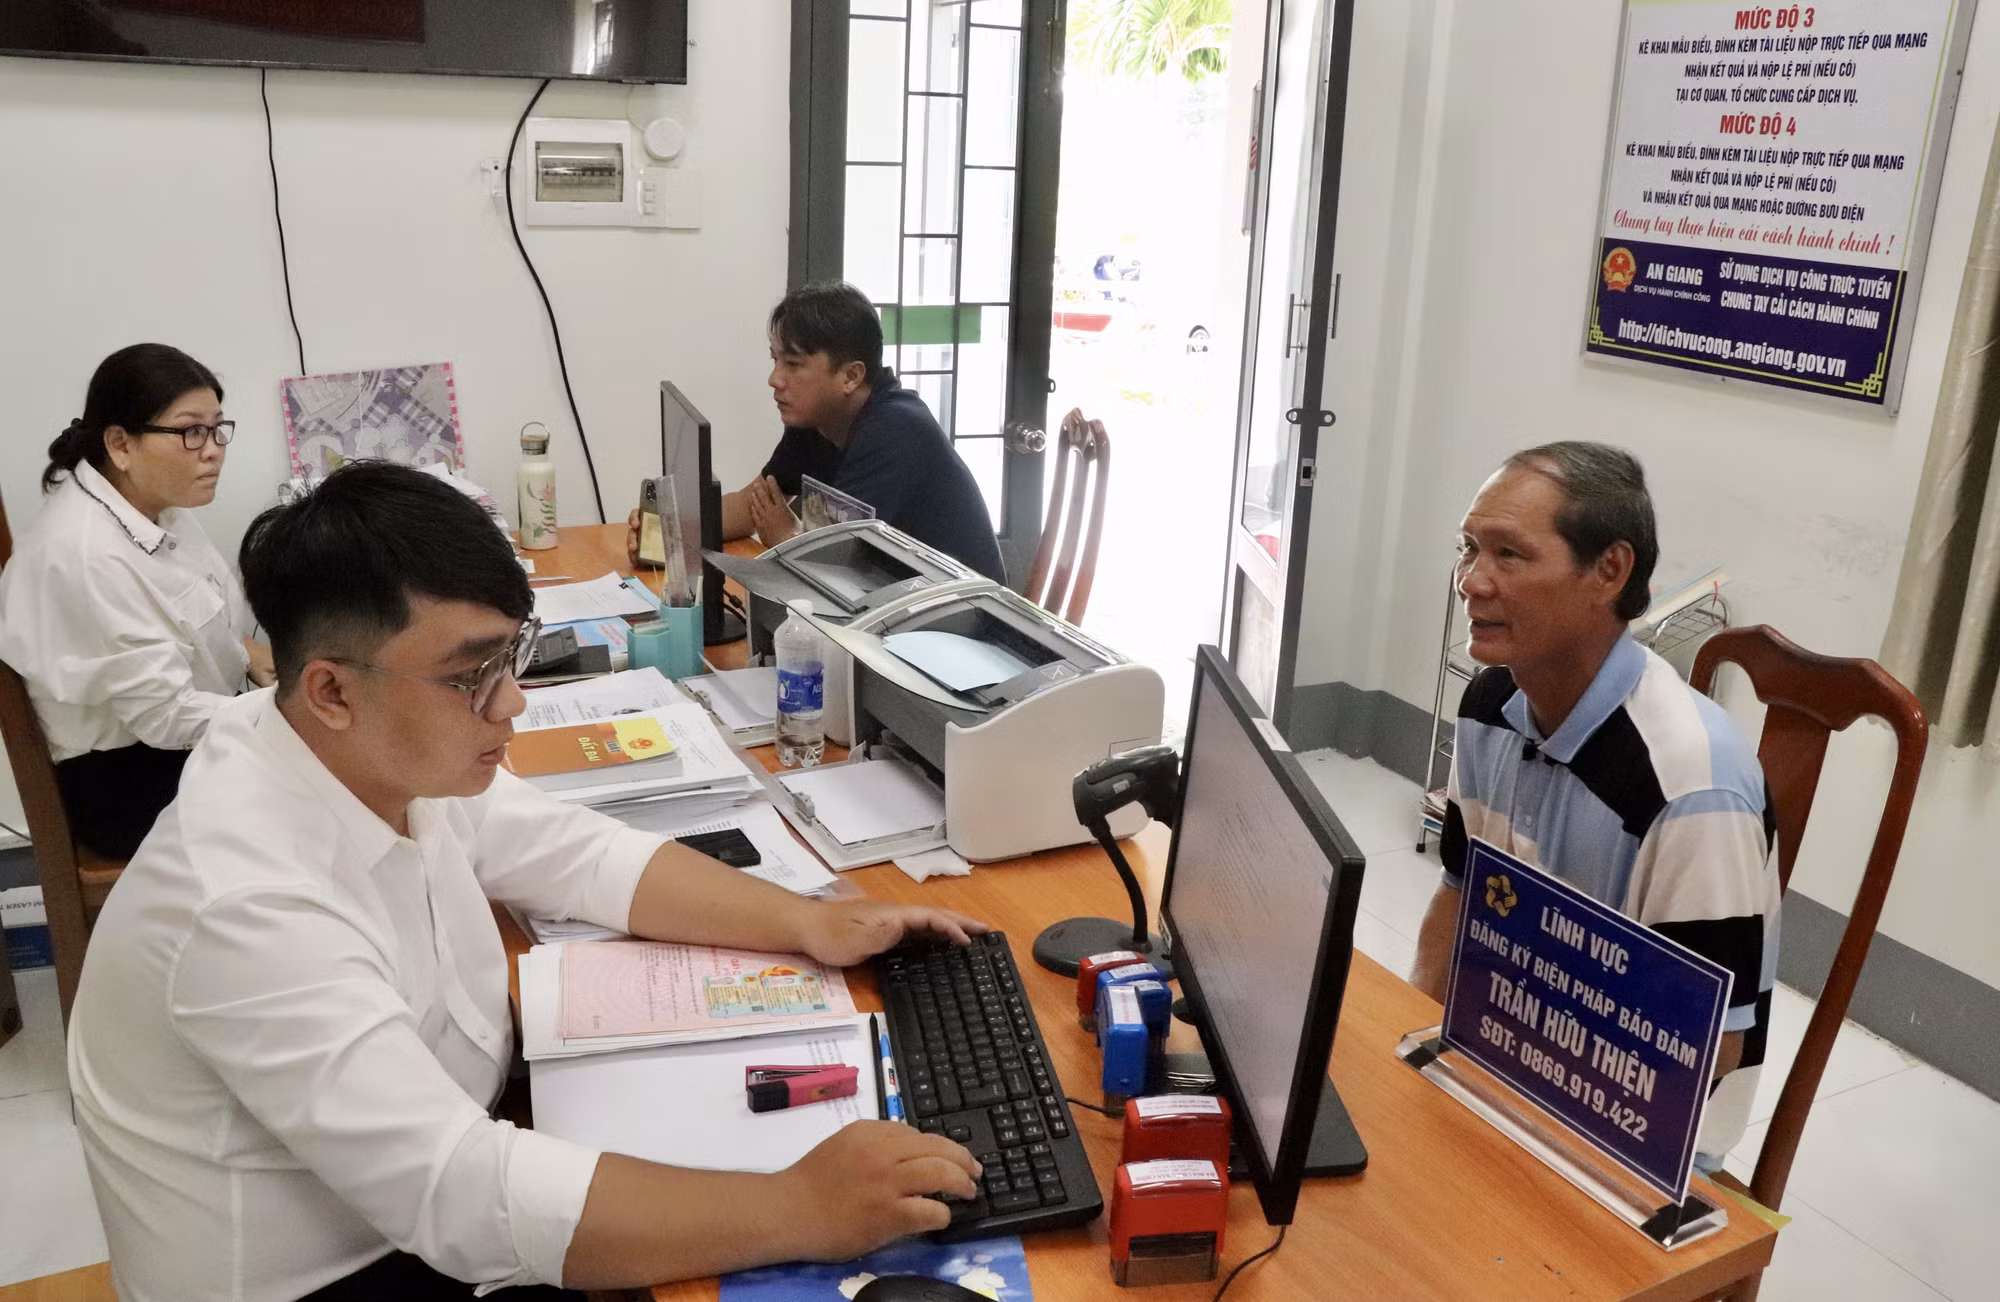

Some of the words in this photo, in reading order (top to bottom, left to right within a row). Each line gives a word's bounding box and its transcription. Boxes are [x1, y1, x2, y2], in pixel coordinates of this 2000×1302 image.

[1735, 6, 1772, 30] MỨC
[1776, 4, 1799, 32] ĐỘ
[1803, 8, 1815, 27] 3
[1651, 41, 1669, 54] KHAI
[1715, 37, 1736, 53] ĐÍNH
[1738, 36, 1758, 52] KÈM
[1760, 36, 1774, 52] TÀI
[1776, 35, 1796, 54] LIỆU
[1798, 34, 1818, 54] NỘP
[1821, 35, 1845, 53] TRỰC
[1848, 30, 1869, 50] TIẾP
[1872, 34, 1892, 51] QUA
[1895, 32, 1928, 51] MẠNG
[1685, 62, 1709, 80] NHẬN
[1710, 60, 1726, 77] KẾT
[1728, 60, 1744, 79] QUẢ
[1748, 61, 1758, 77] VÀ
[1760, 61, 1780, 80] NỘP
[1782, 60, 1793, 80] LỆ
[1794, 60, 1812, 77] PHÍ
[1813, 58, 1837, 78] (NẾU
[1839, 60, 1856, 78] CÓ)
[1676, 88, 1689, 104] TẠI
[1690, 88, 1703, 102] CƠ
[1704, 88, 1728, 103] QUAN,
[1731, 84, 1743, 102] TỔ
[1744, 86, 1767, 102] CHỨC
[1769, 88, 1794, 103] CUNG
[1796, 84, 1816, 103] CẤP
[1818, 89, 1841, 106] DỊCH
[1844, 89, 1858, 107] VỤ.
[1720, 111, 1756, 135] MỨC
[1760, 112, 1782, 140] ĐỘ
[1786, 117, 1796, 136] 4
[1637, 144, 1656, 157] KHAI
[1700, 145, 1720, 160] ĐÍNH
[1722, 146, 1741, 162] KÈM
[1744, 146, 1757, 163] TÀI
[1758, 148, 1778, 166] LIỆU
[1780, 148, 1799, 167] NỘP
[1802, 151, 1826, 169] TRỰC
[1828, 149, 1849, 167] TIẾP
[1852, 154, 1870, 169] QUA
[1873, 154, 1905, 173] MẠNG
[1671, 168, 1693, 186] NHẬN
[1695, 167, 1711, 184] KẾT
[1712, 168, 1729, 185] QUẢ
[1732, 171, 1742, 187] VÀ
[1744, 171, 1763, 190] NỘP
[1764, 173, 1775, 191] LỆ
[1777, 174, 1793, 190] PHÍ
[1795, 174, 1818, 191] (NẾU
[1820, 176, 1837, 194] CÓ)
[1643, 189, 1652, 203] VÀ
[1654, 190, 1677, 207] NHẬN
[1678, 190, 1693, 207] KẾT
[1694, 192, 1711, 208] QUẢ
[1713, 196, 1729, 210] QUA
[1732, 198, 1758, 214] MẠNG
[1760, 198, 1784, 216] HOẶC
[1786, 200, 1817, 218] ĐƯỜNG
[1820, 204, 1840, 219] BƯU
[1841, 204, 1865, 224] ĐIỆN
[1614, 209, 1651, 234] Chung
[1654, 216, 1674, 236] tay
[1677, 216, 1704, 239] thực
[1707, 219, 1735, 242] hiện
[1762, 225, 1793, 246] cách
[1796, 226, 1834, 249] hành
[1838, 231, 1881, 254] chính
[1646, 262, 1664, 280] AN
[1666, 265, 1704, 286] GIANG
[1720, 257, 1734, 279] SỬ
[1734, 264, 1760, 285] DỤNG
[1760, 266, 1784, 288] DỊCH
[1786, 270, 1799, 291] VỤ
[1800, 268, 1827, 292] CÔNG
[1830, 275, 1856, 298] TRỰC
[1858, 275, 1892, 300] TUYẾN
[1634, 284, 1648, 294] DỊCH
[1648, 286, 1657, 296] VỤ
[1656, 286, 1674, 297] HÀNH
[1674, 290, 1692, 300] CHÍNH
[1693, 292, 1711, 303] CÔNG
[1720, 290, 1752, 311] CHUNG
[1754, 294, 1770, 313] TAY
[1770, 292, 1788, 316] CẢI
[1788, 297, 1816, 320] CÁCH
[1816, 301, 1846, 325] HÀNH
[1846, 306, 1880, 329] CHÍNH
[1618, 318, 1847, 378] http://dichvucong.angiang.gov.vn
[1540, 906, 1584, 951] LĨNH
[1590, 935, 1629, 975] VỰC
[1470, 919, 1508, 958] ĐĂNG
[1512, 941, 1532, 968] KÝ
[1533, 955, 1570, 993] BIỆN
[1572, 982, 1615, 1019] PHÁP
[1618, 1005, 1652, 1042] BẢO
[1656, 1030, 1697, 1070] ĐẢM
[1490, 971, 1540, 1031] TRẦN
[1543, 1005, 1587, 1058] HỮU
[1591, 1034, 1656, 1103] THIỆN
[1479, 1015, 1516, 1056] SĐT:
[1520, 1041, 1648, 1143] 0869.919.422
